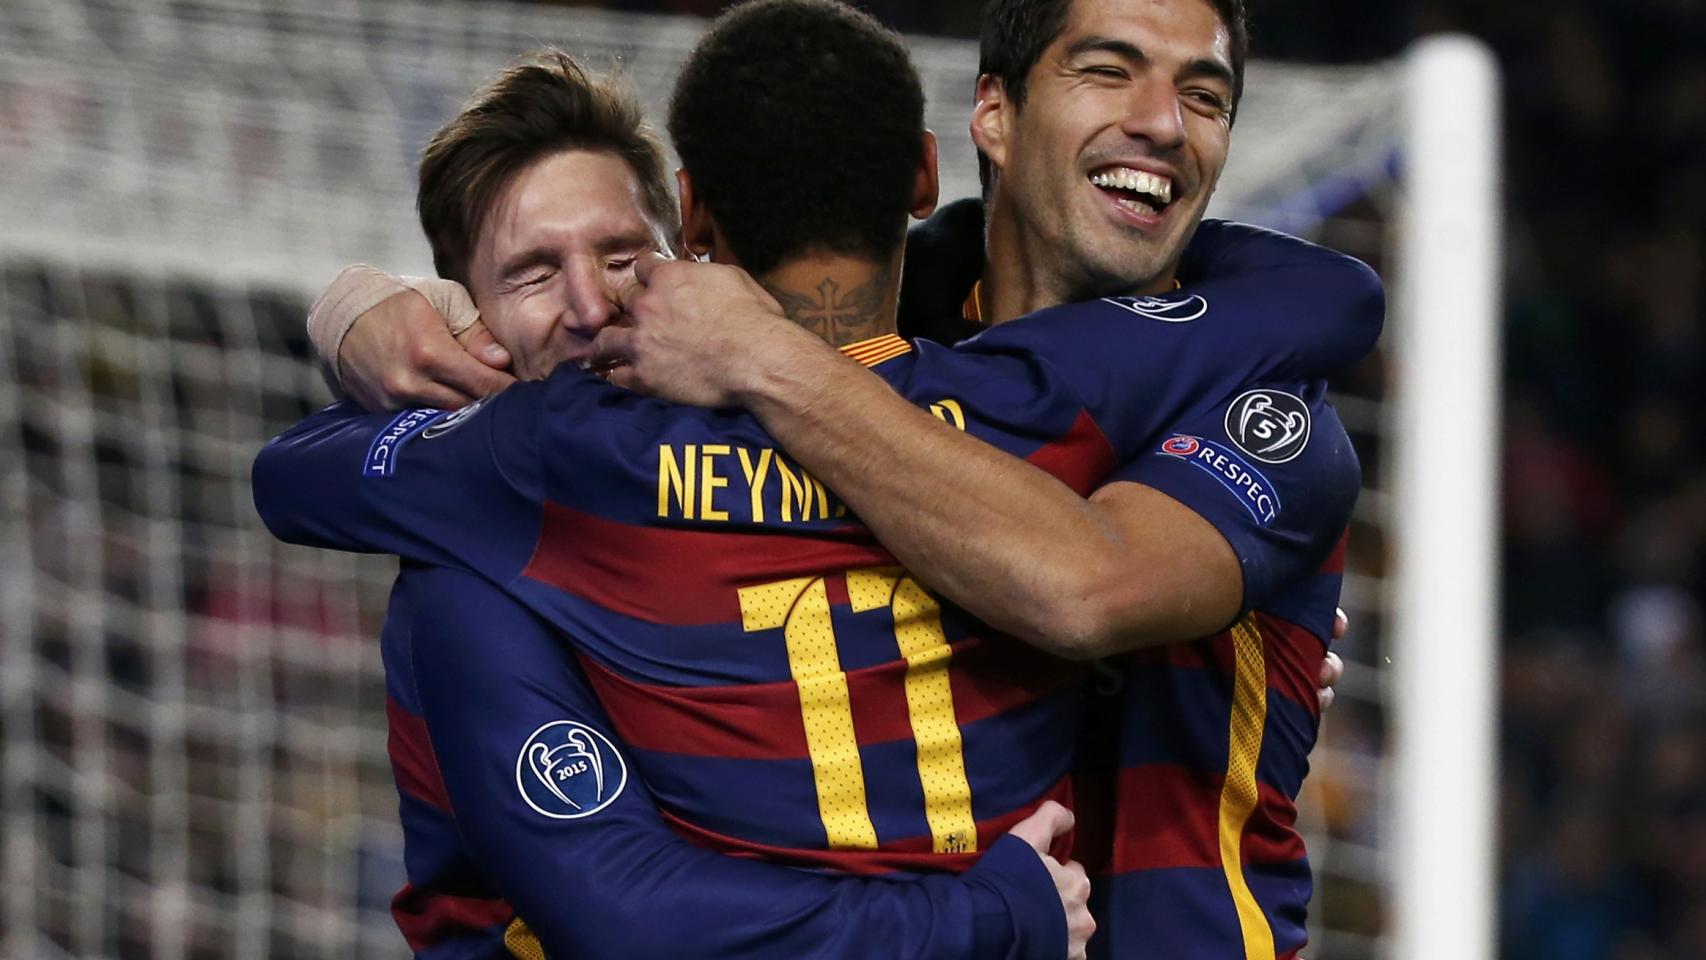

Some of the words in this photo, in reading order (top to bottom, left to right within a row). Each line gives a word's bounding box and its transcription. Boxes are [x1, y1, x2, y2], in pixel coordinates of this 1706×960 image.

[1253, 419, 1277, 439] 5
[657, 444, 846, 523] NEYM
[1198, 447, 1275, 522] RESPECT
[737, 565, 977, 854] 11
[556, 760, 588, 781] 2015
